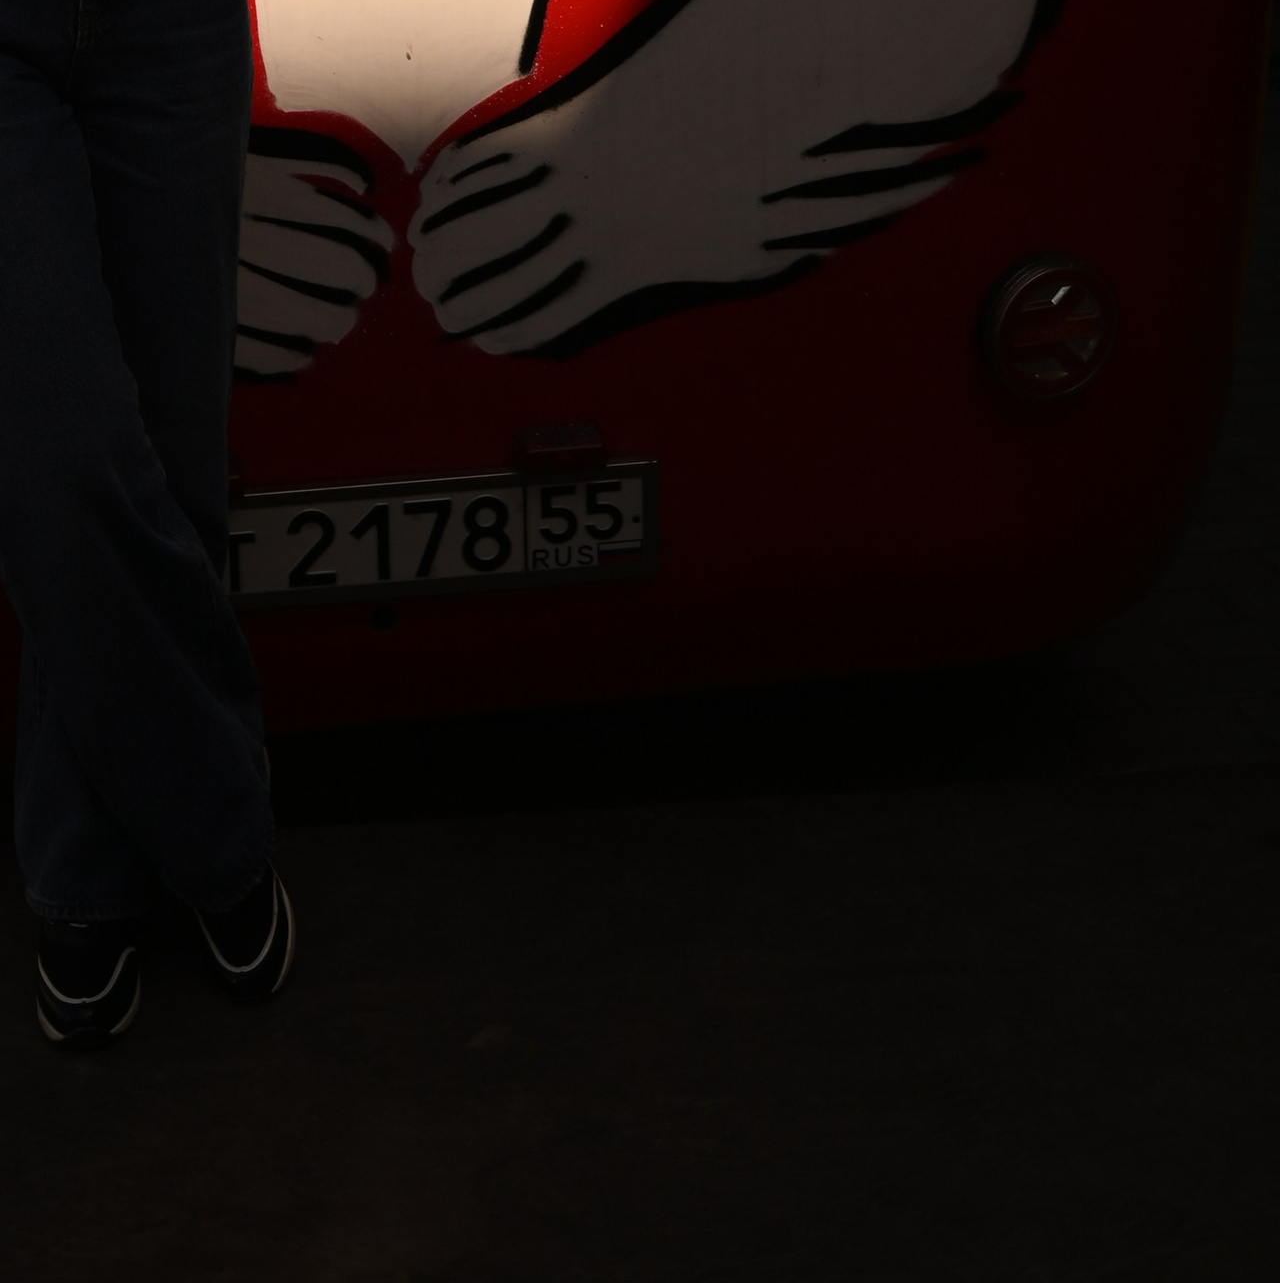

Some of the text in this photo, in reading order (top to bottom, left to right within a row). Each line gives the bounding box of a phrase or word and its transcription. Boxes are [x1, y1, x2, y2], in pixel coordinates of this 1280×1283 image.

[287, 496, 512, 587] 2178
[539, 480, 623, 544] 55
[532, 544, 595, 570] RUS
